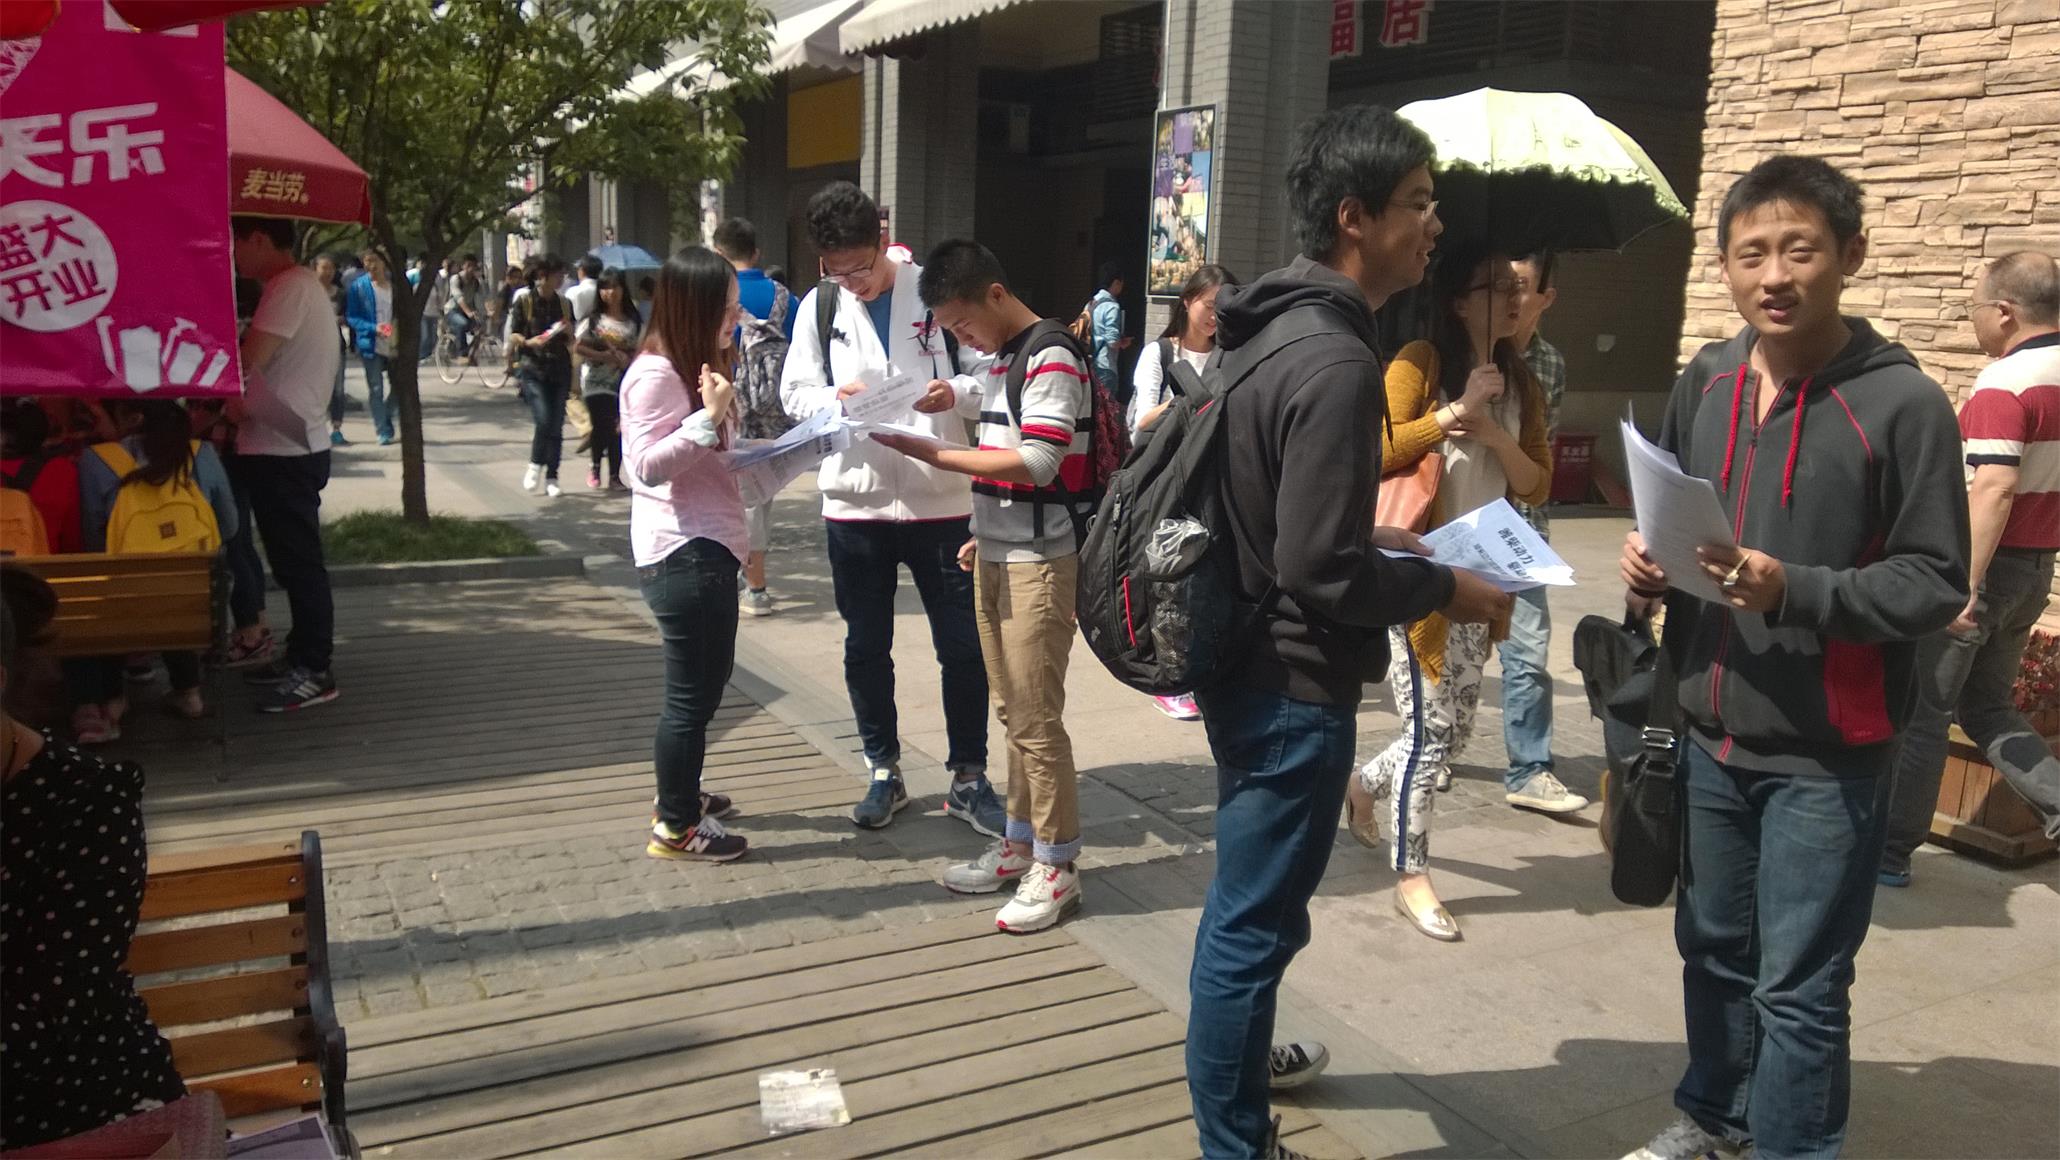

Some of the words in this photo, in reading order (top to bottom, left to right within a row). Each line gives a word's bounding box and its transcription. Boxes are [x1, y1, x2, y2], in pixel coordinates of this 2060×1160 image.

[240, 167, 307, 203] 麦当劳
[0, 214, 85, 271] 盛大
[0, 258, 107, 319] 开业
